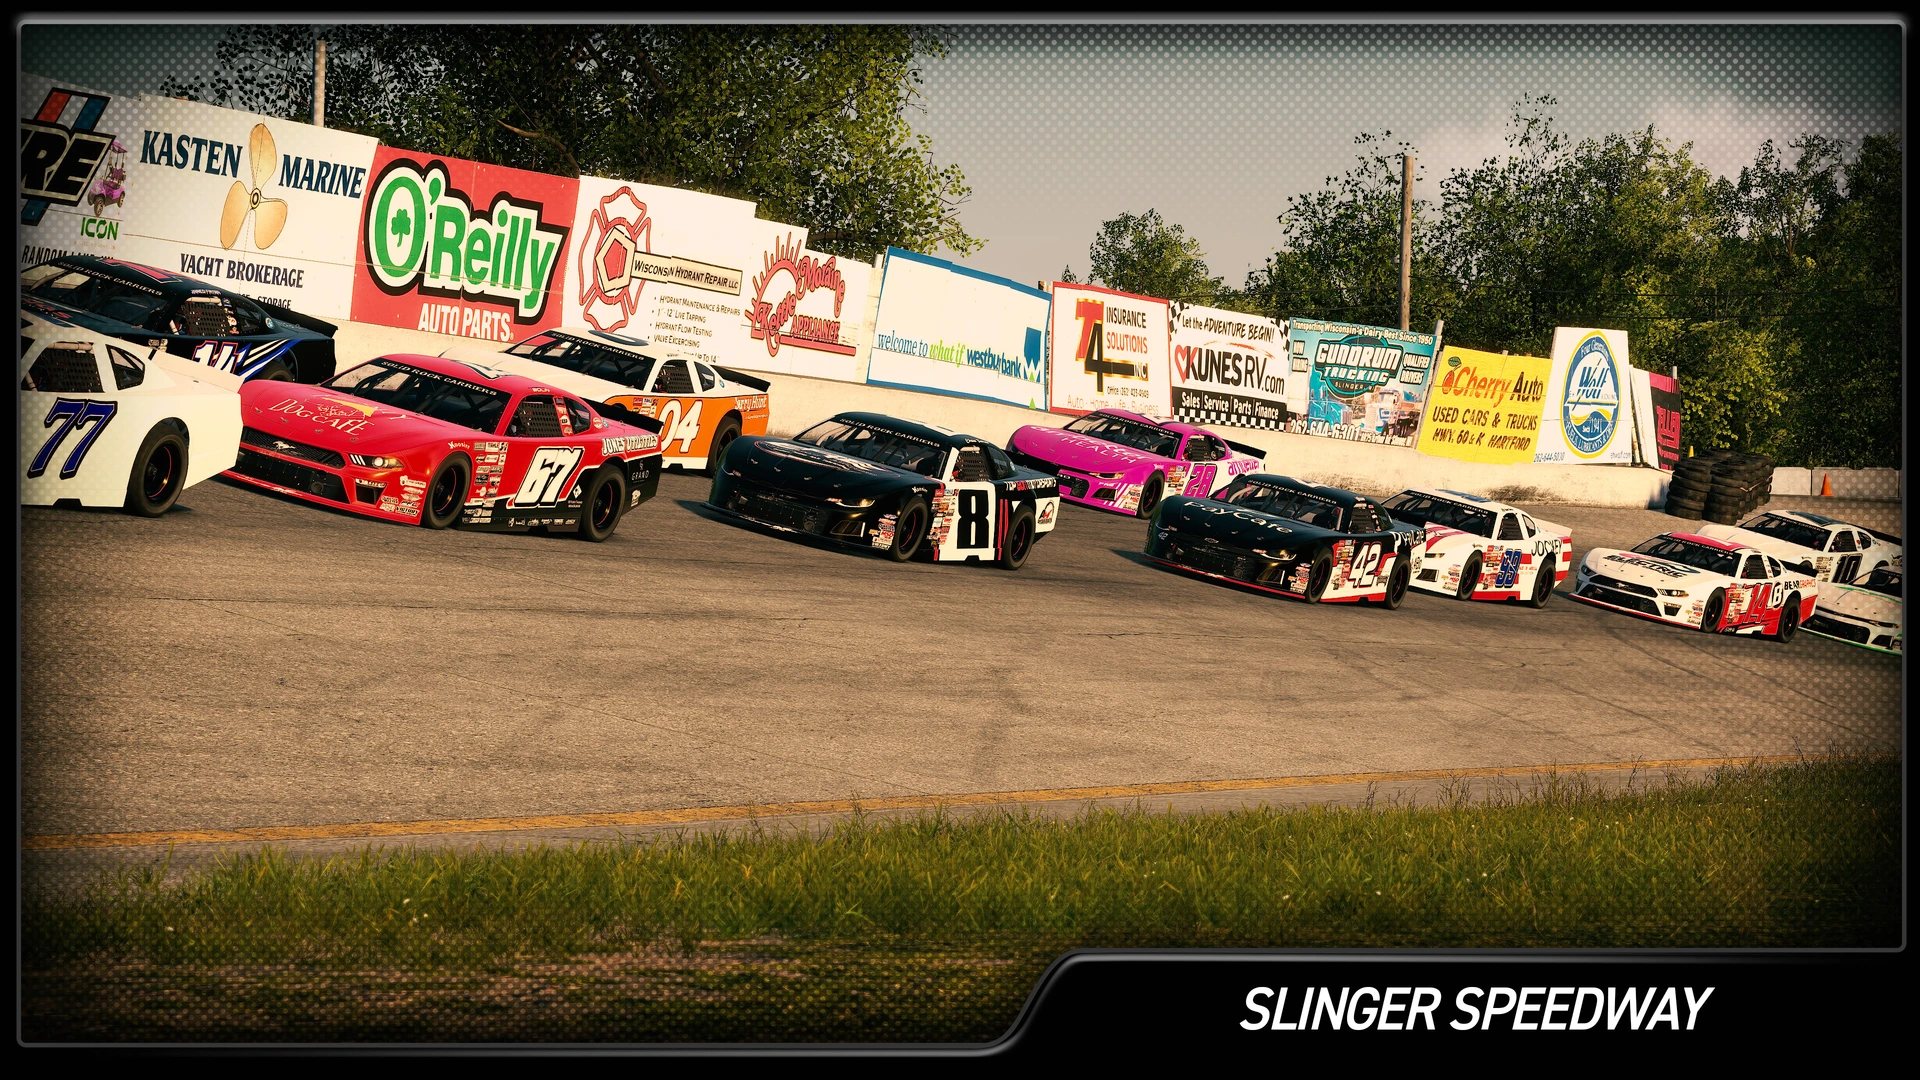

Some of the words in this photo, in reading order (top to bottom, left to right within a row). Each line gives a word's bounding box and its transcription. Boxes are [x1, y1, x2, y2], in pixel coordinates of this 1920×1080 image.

[140, 129, 243, 178] KASTEN
[278, 154, 367, 199] MARINE
[80, 217, 119, 241] ICON
[372, 174, 558, 312] O'Reilly
[85, 268, 114, 281] ROCK
[113, 277, 163, 296] CARRIERS
[180, 253, 224, 277] YACHT
[226, 259, 305, 288] BROKERAGE
[634, 259, 674, 278] WISCONSIN
[674, 265, 705, 282] HYDRANT
[704, 272, 728, 288] REPAIR
[728, 280, 739, 290] LLC
[417, 303, 460, 336] AUTO
[660, 295, 682, 306] HYDRANT
[682, 298, 715, 312] MAINTENANCE
[720, 305, 741, 316] REPAIRS
[675, 309, 685, 320] LIVE
[685, 312, 706, 323] TAPPING
[1106, 306, 1147, 329] INSURANCE
[654, 334, 669, 343] VALVE
[655, 321, 678, 332] HYDRANT
[677, 323, 691, 334] FLOW
[692, 326, 712, 338] TESTING
[790, 314, 841, 344] APPLIANCE
[1106, 331, 1148, 354] SOLUTIONS
[1182, 315, 1192, 328] Let
[1192, 317, 1203, 330] the
[1203, 317, 1246, 339] ADVENTURE
[1248, 324, 1275, 343] BEGIN!
[1293, 321, 1324, 334] Transporting
[1324, 322, 1363, 336] Wisconsin's
[1363, 328, 1382, 340] Dairy
[1383, 330, 1399, 341] Best
[1399, 332, 1417, 343] Since
[1417, 335, 1433, 346] 1950
[576, 338, 600, 348] ROCK
[601, 345, 645, 361] CARRIERS
[878, 330, 918, 355] welcome
[918, 338, 928, 357] to
[929, 340, 955, 363] what
[955, 342, 966, 368] if
[1316, 343, 1402, 370] GUNDRUM
[380, 361, 410, 371] SOLID
[411, 367, 441, 380] ROCK
[442, 377, 497, 396] CARRIERS
[1323, 366, 1389, 383] TRUCKING
[1453, 366, 1512, 408] Cherry
[1509, 371, 1544, 403] Auto
[1578, 366, 1610, 399] Wolf
[268, 398, 313, 419] DOG
[312, 414, 375, 436] CAFE
[1067, 395, 1084, 408] Auto
[1090, 398, 1108, 409] Home
[1115, 399, 1126, 410] Life
[1131, 400, 1159, 413] Business
[1181, 391, 1200, 409] Sales
[1203, 394, 1229, 413] Service
[1233, 398, 1252, 415] Parts
[1255, 400, 1279, 419] Finance
[1432, 406, 1459, 424] USED
[1462, 408, 1489, 427] CARS
[1491, 412, 1501, 428] &
[1506, 413, 1538, 431] TRUCKS
[27, 397, 118, 480] 77
[659, 399, 703, 453] 04
[839, 417, 867, 427] SOLID
[868, 424, 896, 435] ROCK
[896, 432, 941, 448] CARRIERS
[1061, 437, 1137, 463] HEALTH
[1488, 434, 1531, 451] HARTFORD
[514, 447, 584, 508] 67
[1183, 463, 1217, 498] 28
[1272, 485, 1296, 494] ROCK
[1296, 490, 1338, 505] CARRIERS
[957, 489, 989, 549] 8
[1183, 500, 1293, 534] PayCare
[1348, 541, 1382, 588] 42
[1743, 582, 1773, 624] 14
